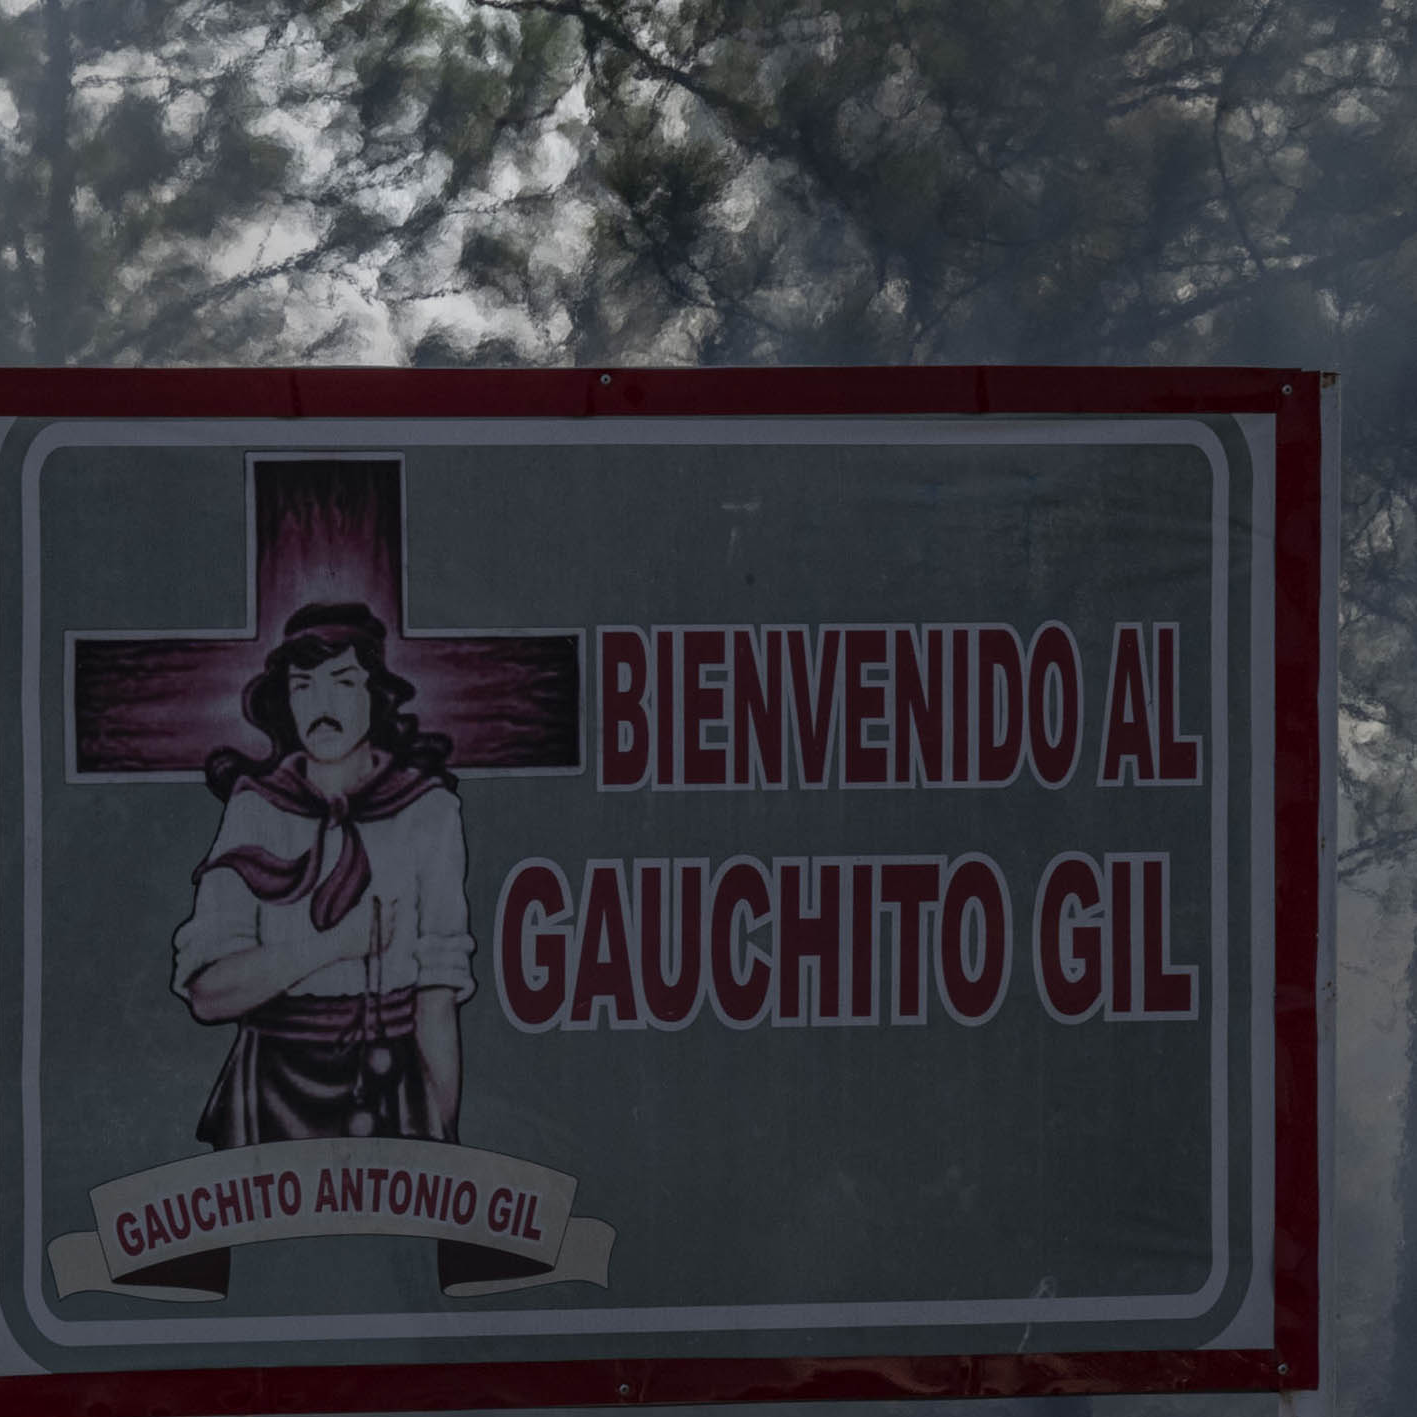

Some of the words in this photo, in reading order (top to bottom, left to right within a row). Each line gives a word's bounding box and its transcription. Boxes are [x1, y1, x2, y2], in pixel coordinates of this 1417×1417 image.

[596, 620, 1084, 791] BIENVENIDO
[1096, 621, 1203, 787] AL
[493, 852, 1014, 1033] GAUCHITO
[1033, 850, 1199, 1025] GIL
[115, 1170, 302, 1258] GAUCHITO
[314, 1168, 477, 1226] ANTONIO
[487, 1187, 542, 1241] GIL
